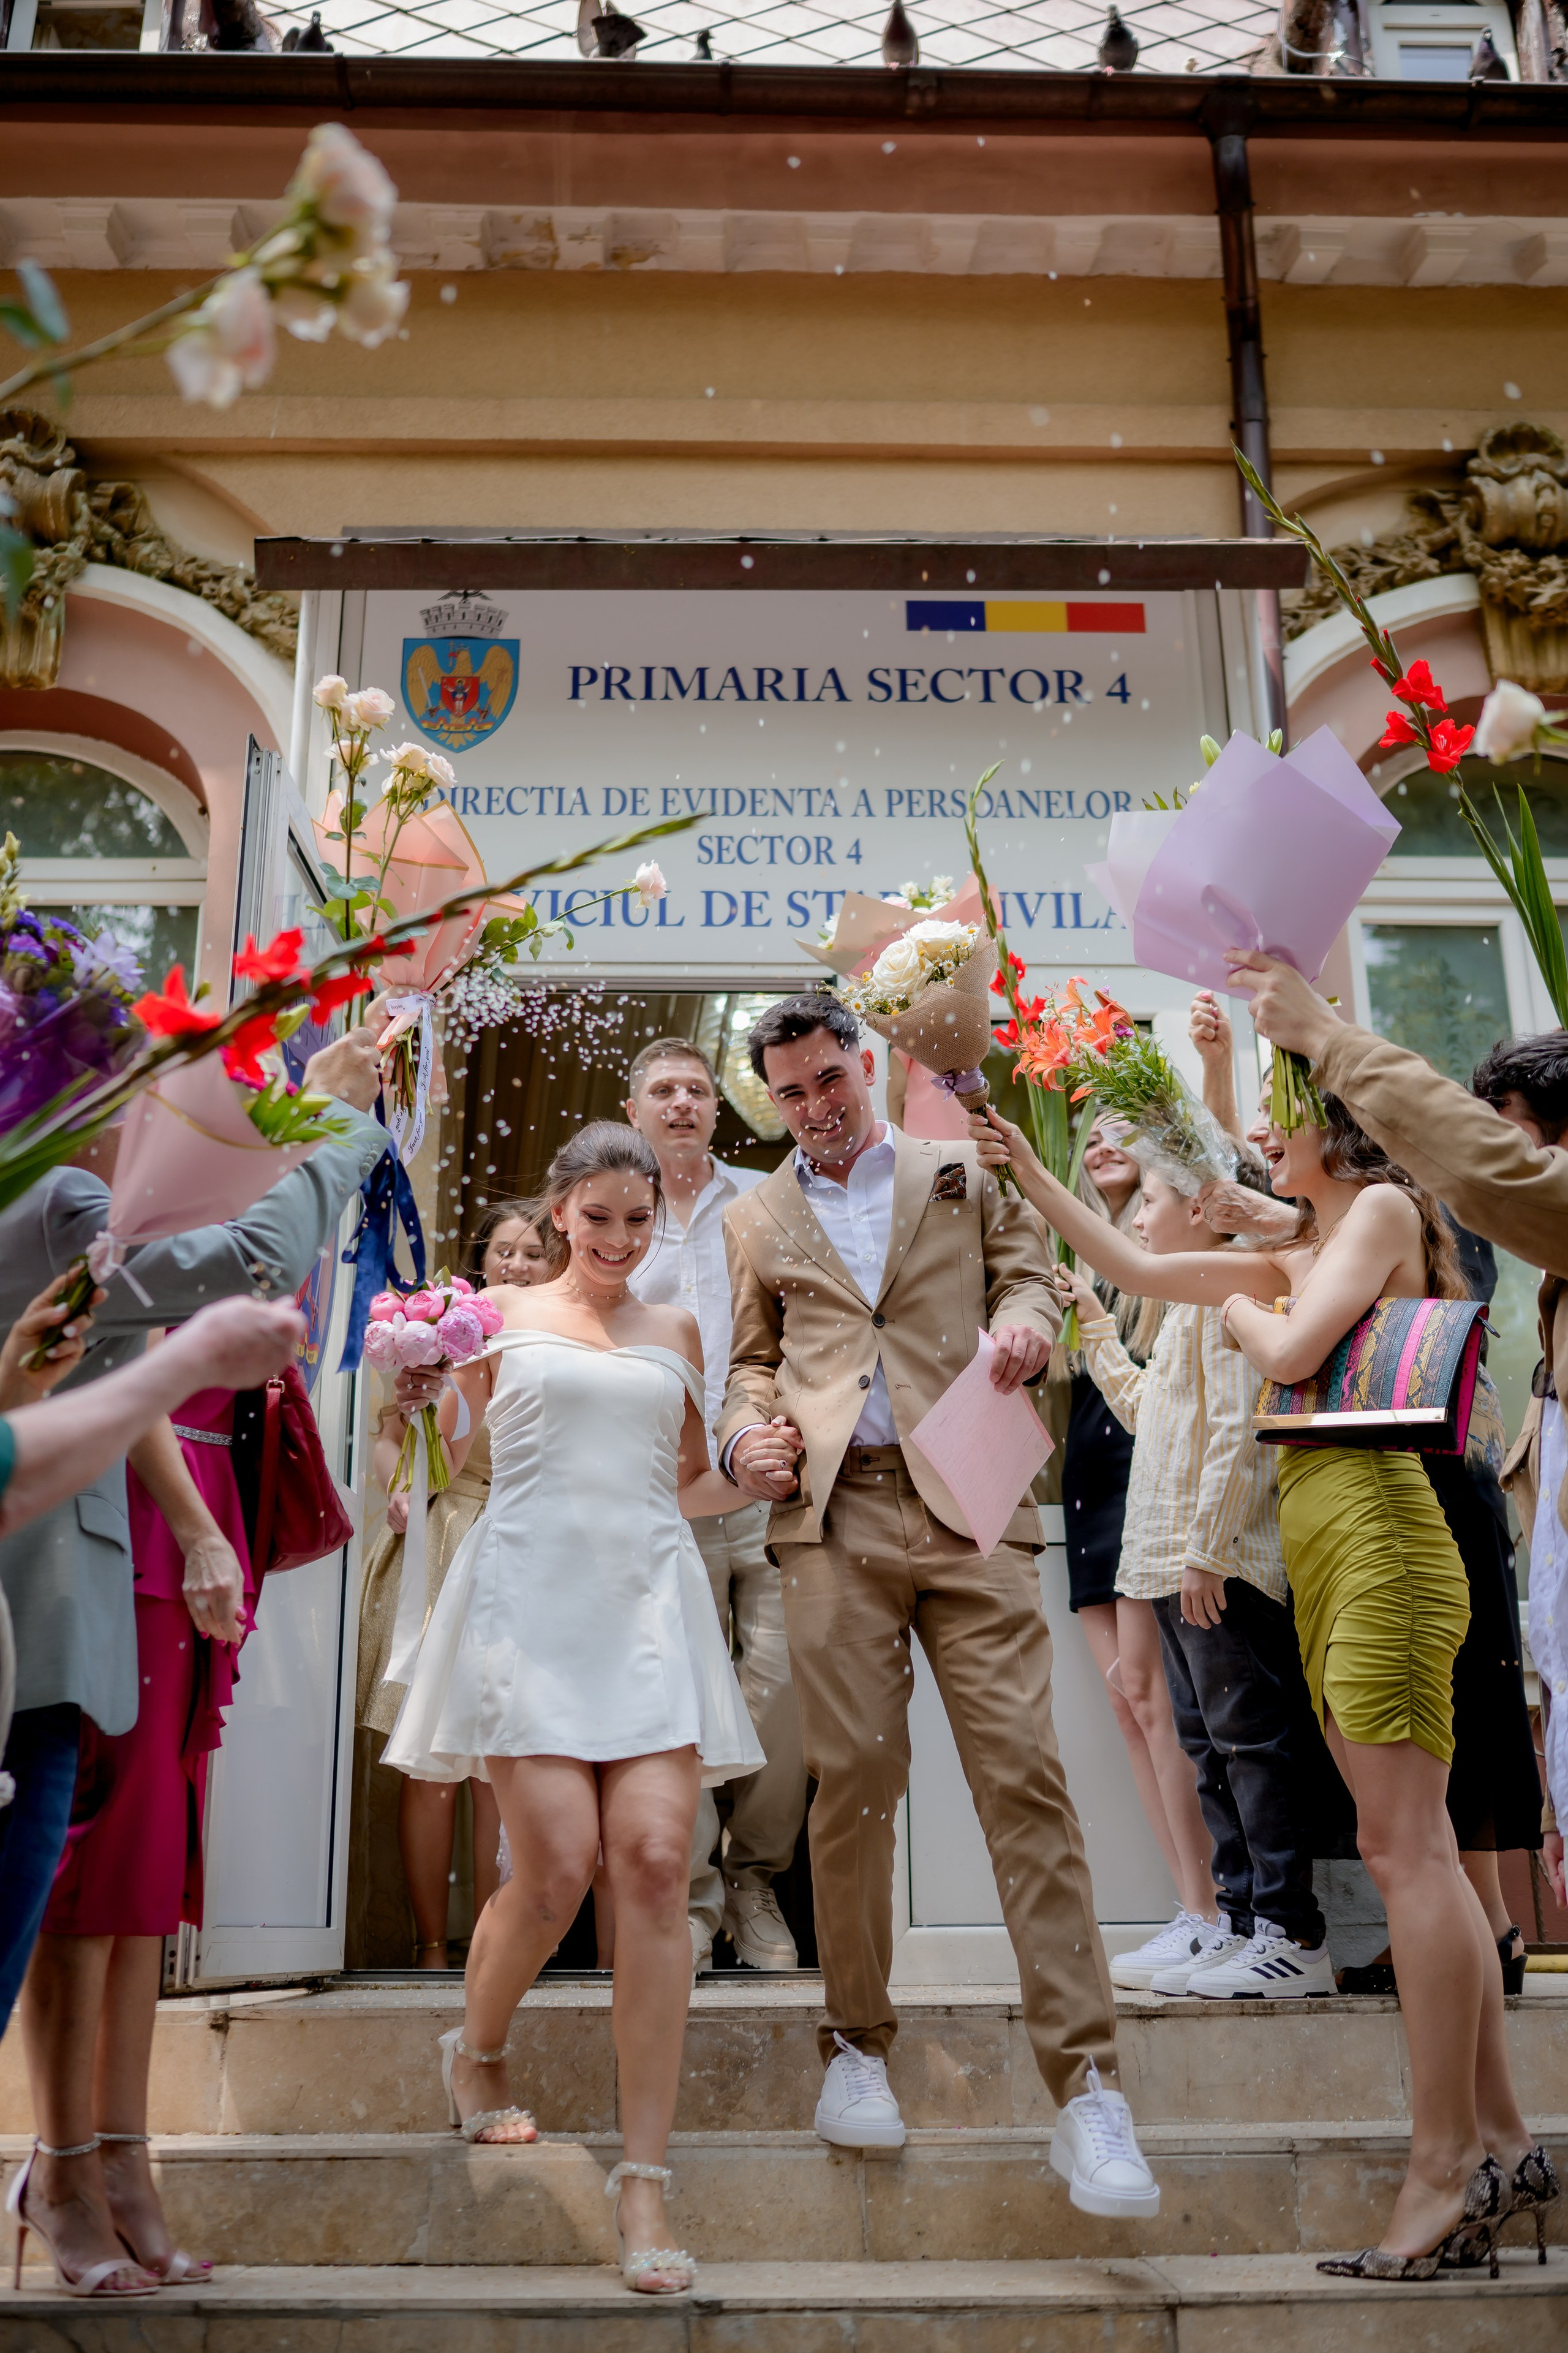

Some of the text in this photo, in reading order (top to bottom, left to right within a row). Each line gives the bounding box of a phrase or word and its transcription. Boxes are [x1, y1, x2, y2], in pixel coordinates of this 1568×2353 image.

[567, 666, 1132, 704] PRIMARIA SECTOR 4
[602, 787, 650, 816] DE
[660, 788, 843, 818] EVIDENTA
[851, 788, 876, 817] A
[884, 789, 1131, 820] PERSOANELOR
[697, 834, 862, 865] SECTOR 4
[700, 890, 772, 927] DE
